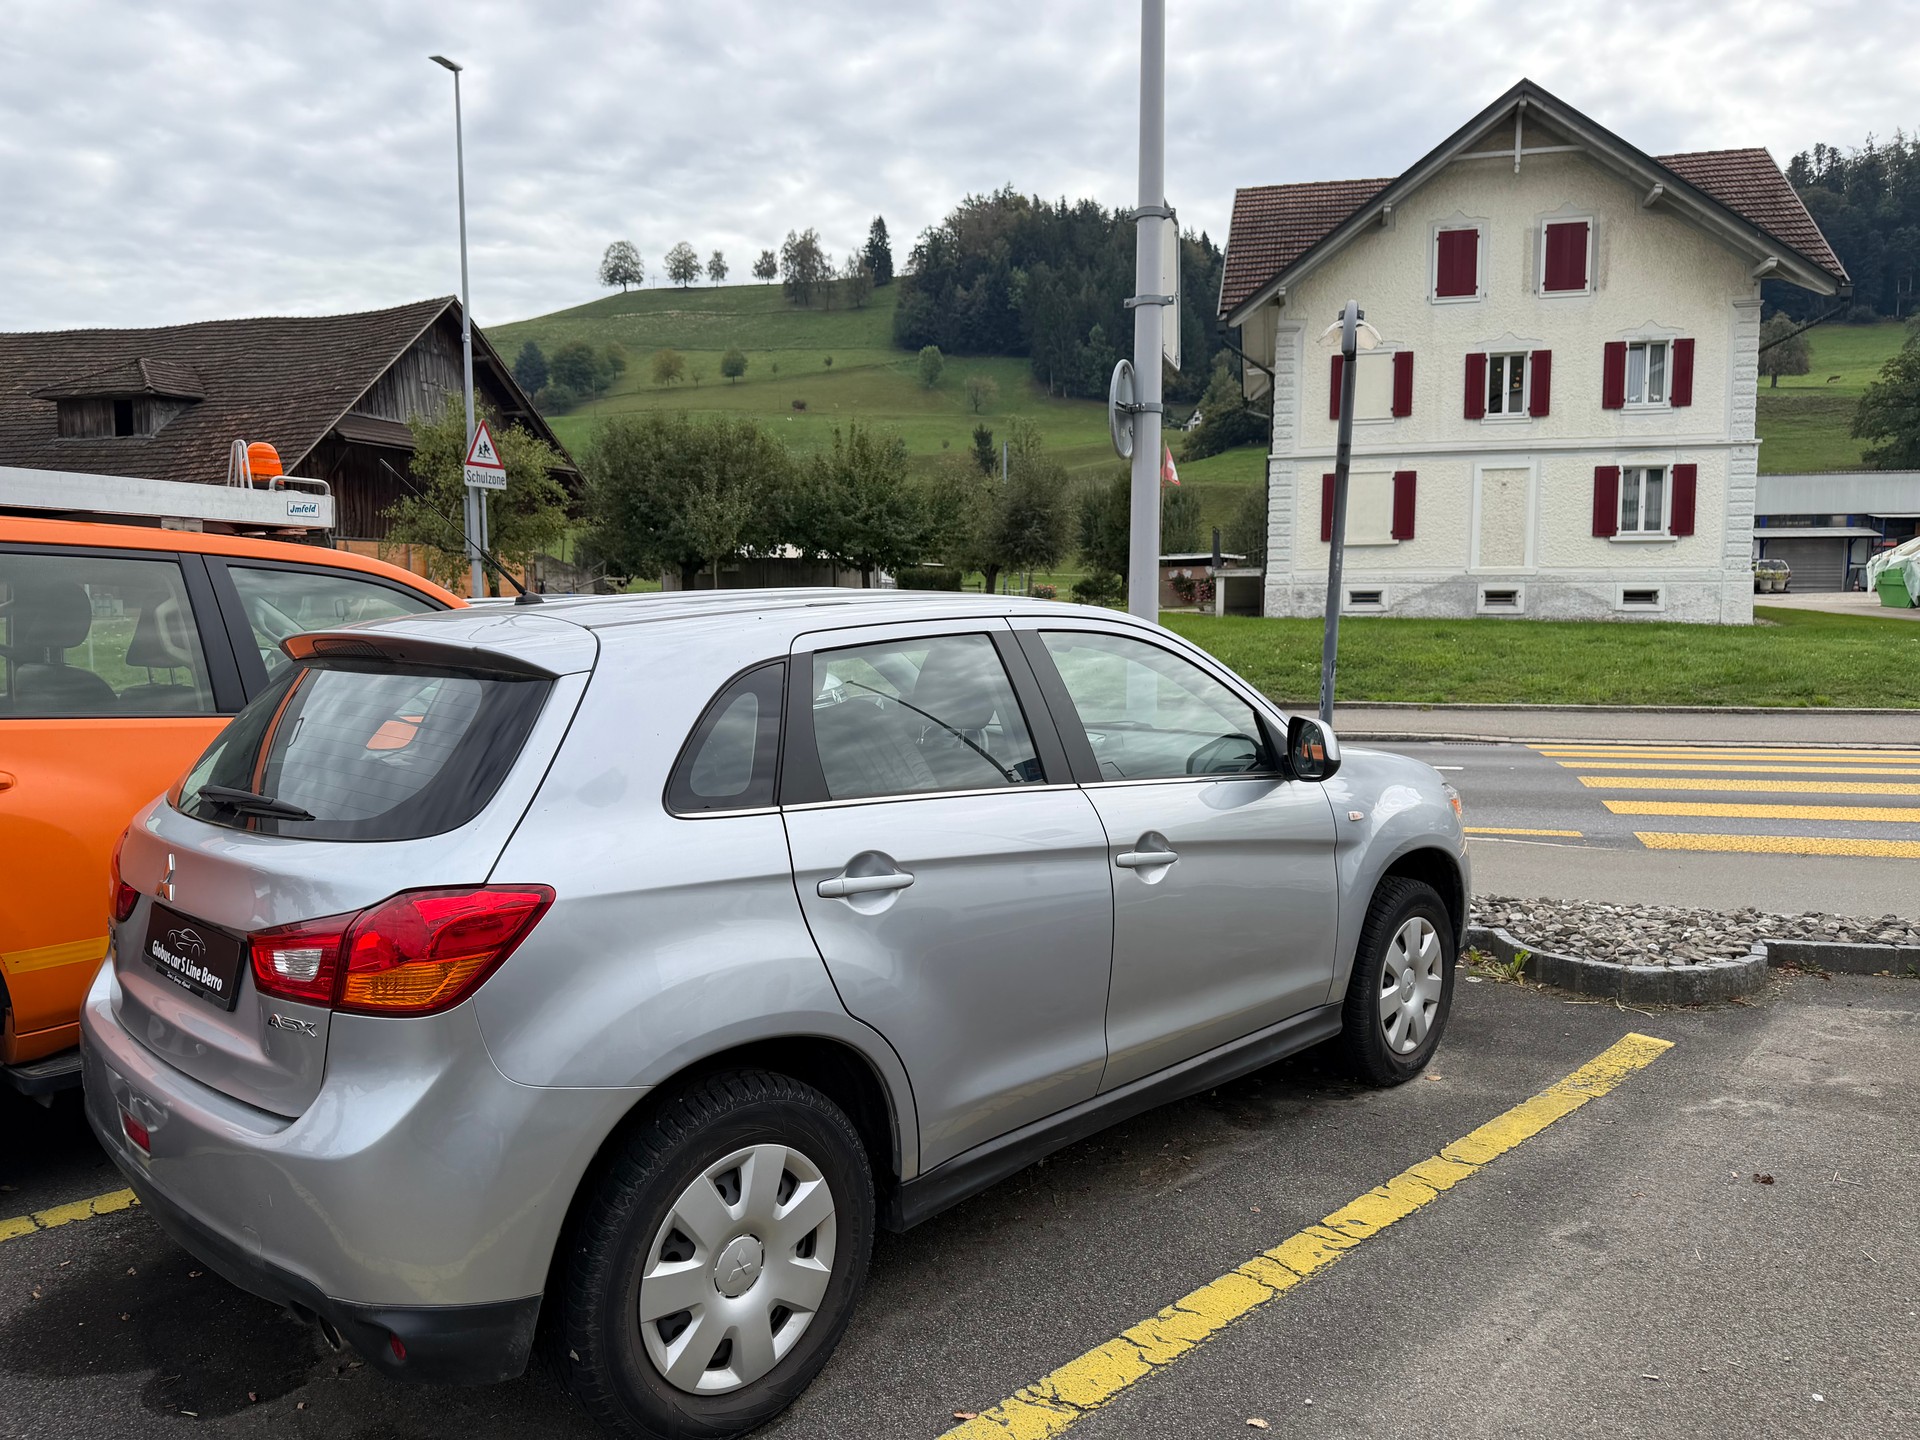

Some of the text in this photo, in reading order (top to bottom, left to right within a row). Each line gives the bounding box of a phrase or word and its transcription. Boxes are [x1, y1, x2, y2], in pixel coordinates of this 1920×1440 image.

[466, 469, 506, 486] Schulzone
[152, 940, 171, 964] Globus
[170, 955, 181, 970] car
[180, 956, 187, 973] S
[185, 958, 202, 981] Line
[201, 966, 223, 992] Berro
[268, 1012, 318, 1038] ASX
